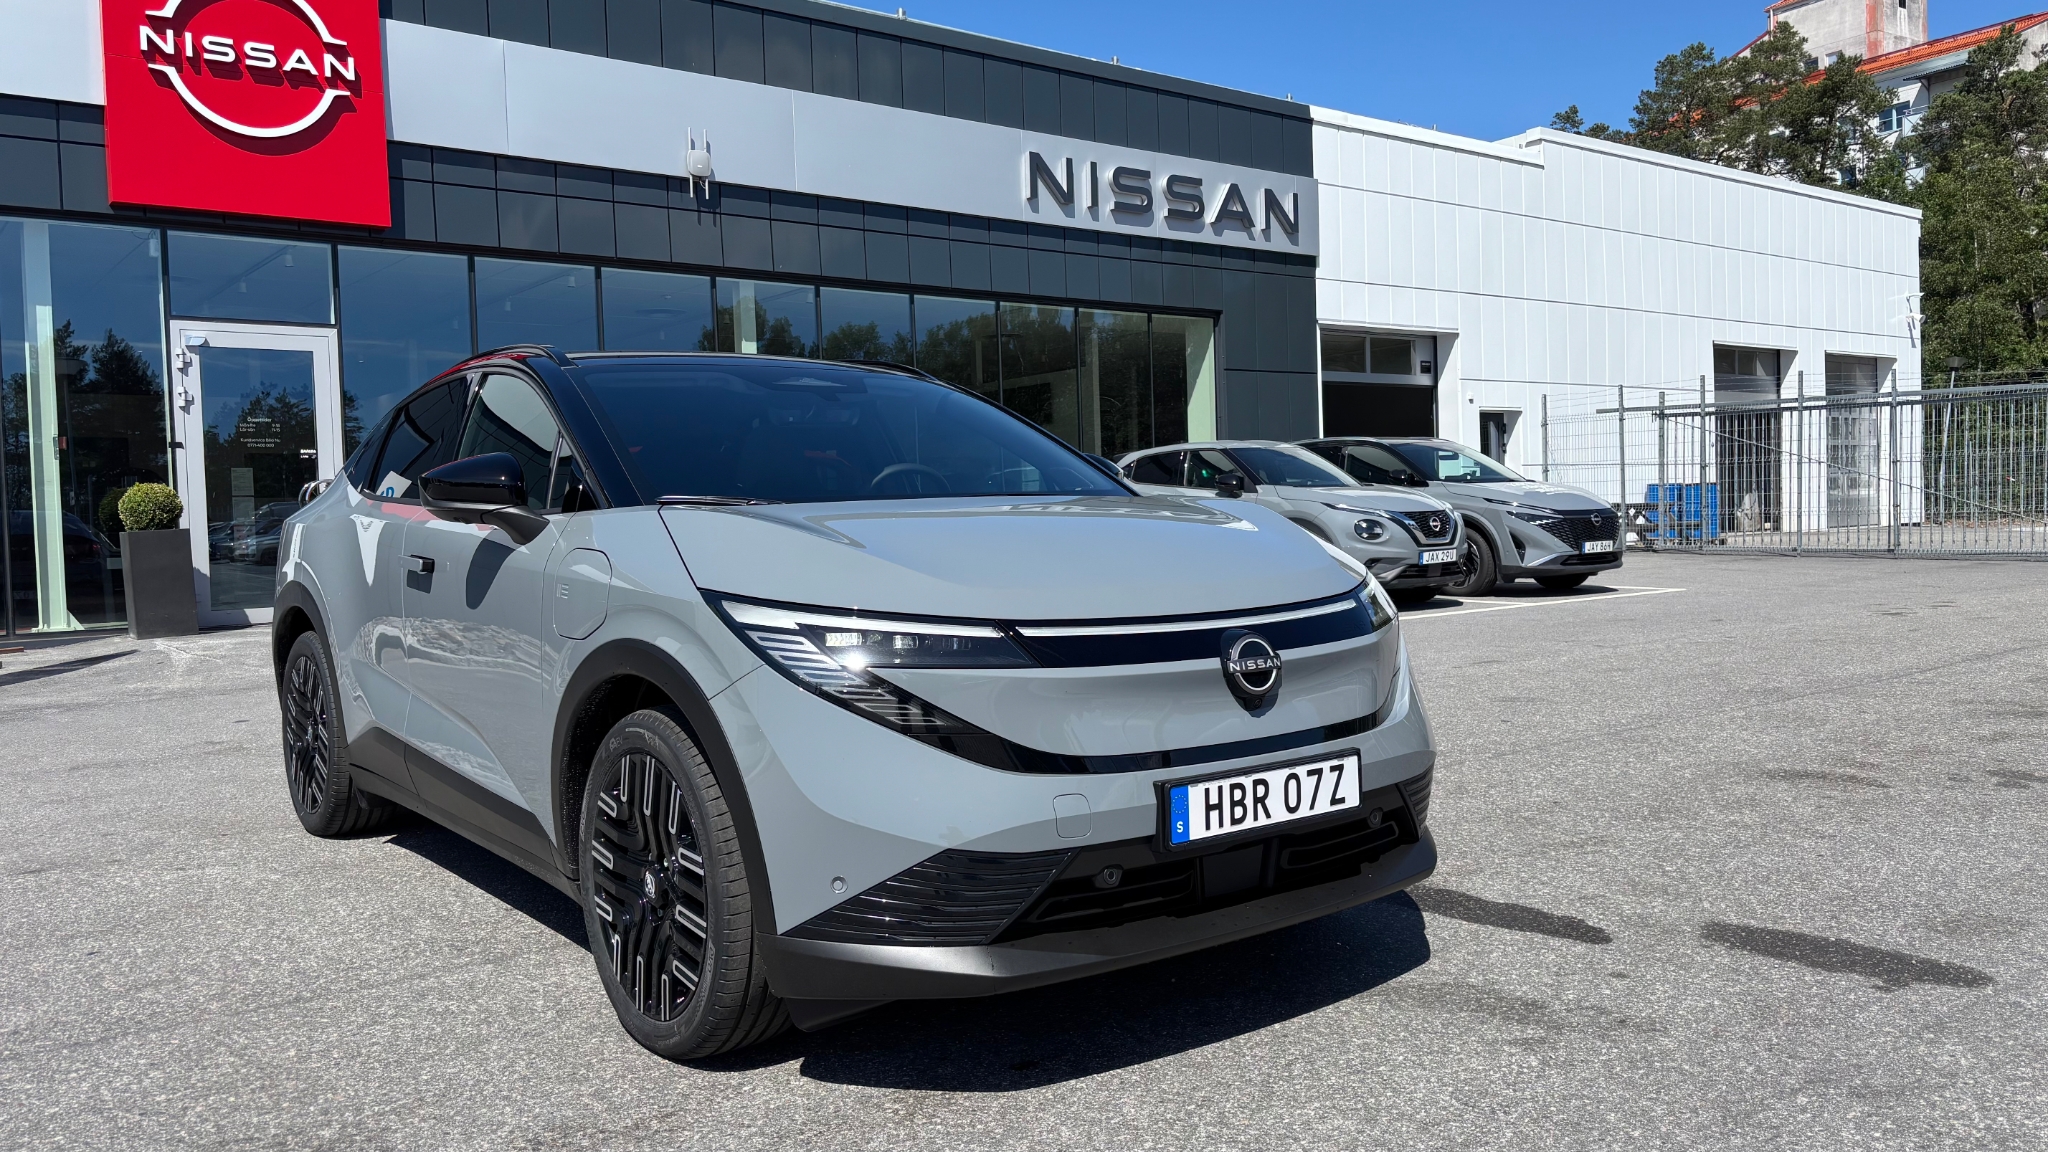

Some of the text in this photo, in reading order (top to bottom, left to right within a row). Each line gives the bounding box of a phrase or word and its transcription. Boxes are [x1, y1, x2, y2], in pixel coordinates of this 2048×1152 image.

[139, 24, 356, 81] NISSAN
[1026, 150, 1299, 235] NISSAN
[1426, 550, 1455, 563] JAX 29U
[1229, 658, 1281, 672] NISSAN
[1176, 763, 1346, 833] S HBR 07Z
